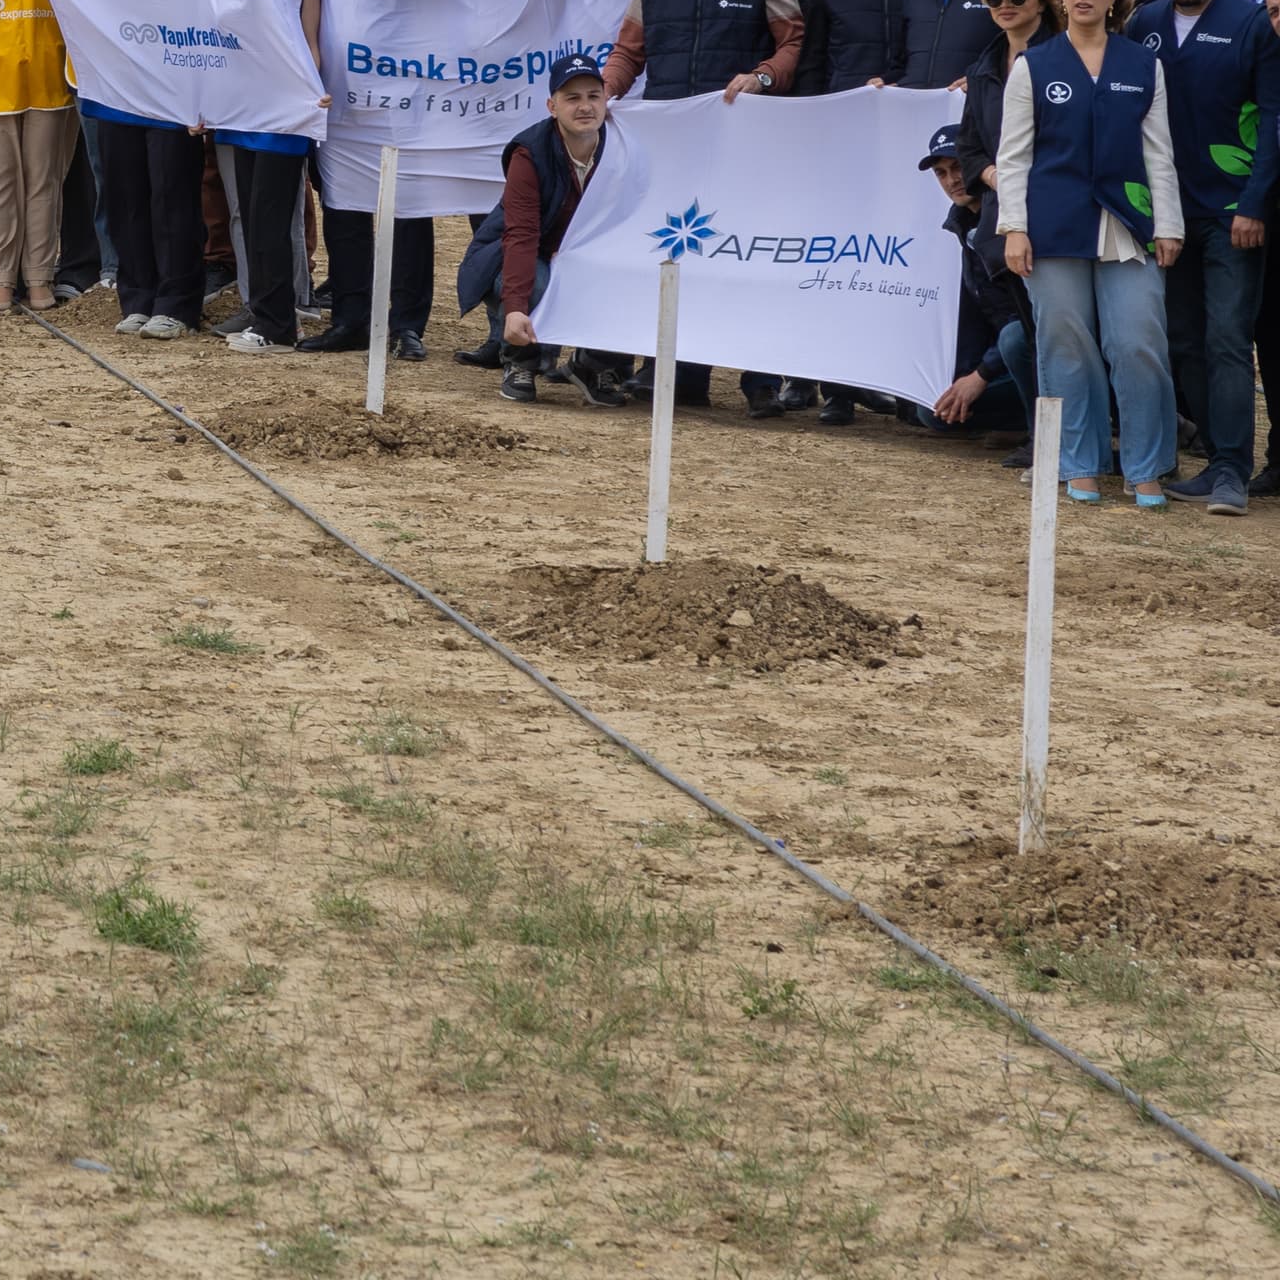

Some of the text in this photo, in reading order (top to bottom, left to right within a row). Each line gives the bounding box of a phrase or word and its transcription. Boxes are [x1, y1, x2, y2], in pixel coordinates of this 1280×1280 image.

[0, 7, 56, 22] expressban
[162, 48, 228, 71] Azərbaycan
[346, 41, 449, 82] Bank
[798, 268, 941, 308] Hər kəs üçün eyni
